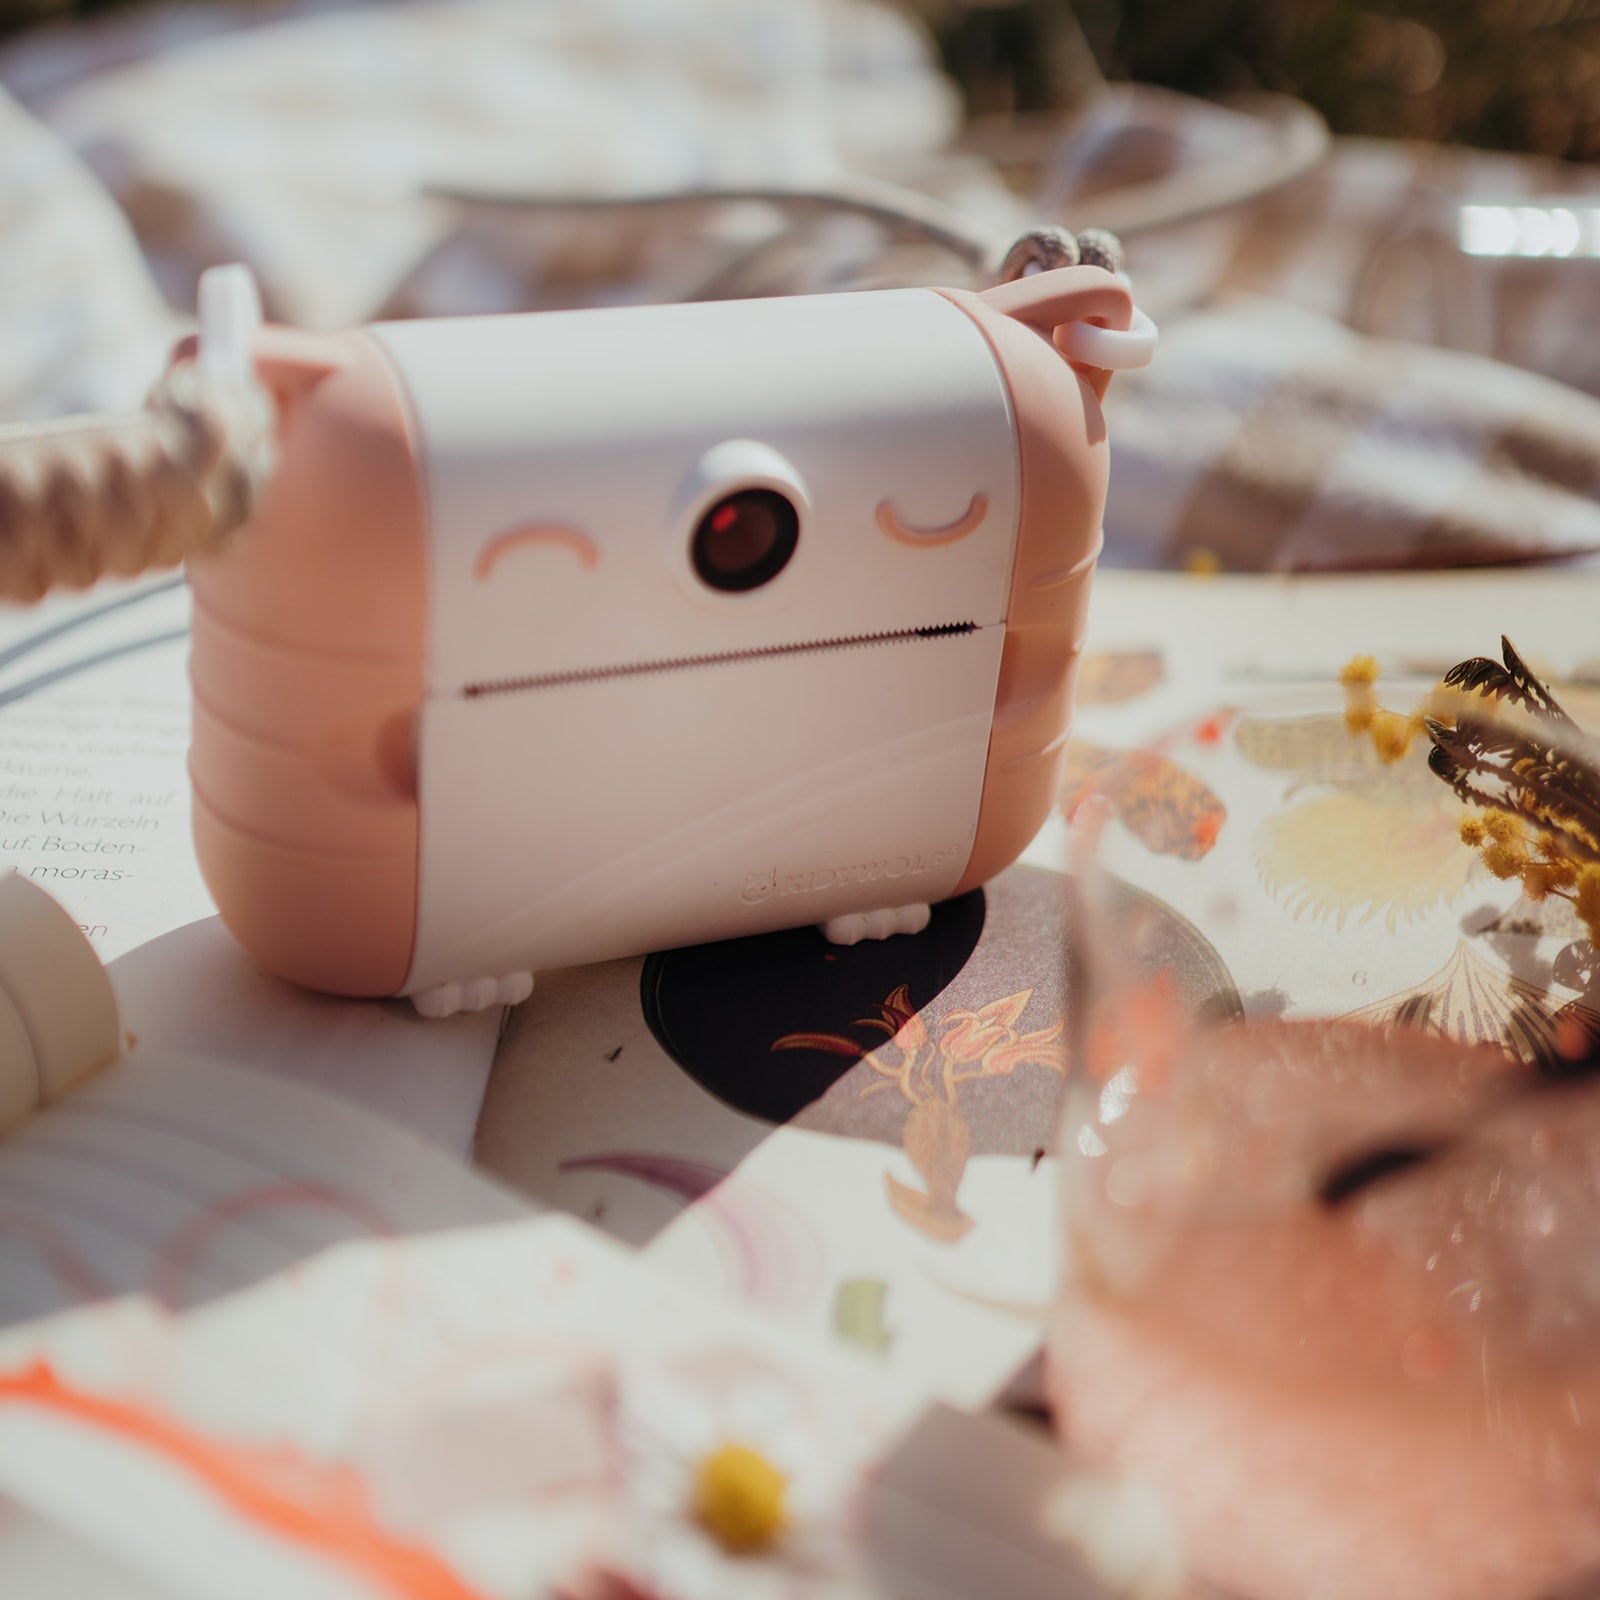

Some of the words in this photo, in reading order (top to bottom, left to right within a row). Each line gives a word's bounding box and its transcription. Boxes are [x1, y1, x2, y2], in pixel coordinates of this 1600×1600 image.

[55, 786, 114, 804] Halt
[129, 790, 175, 806] auf
[41, 810, 160, 831] Wurzeln
[41, 836, 148, 855] Boden-
[30, 866, 135, 881] moras-
[1351, 969, 1368, 987] 6
